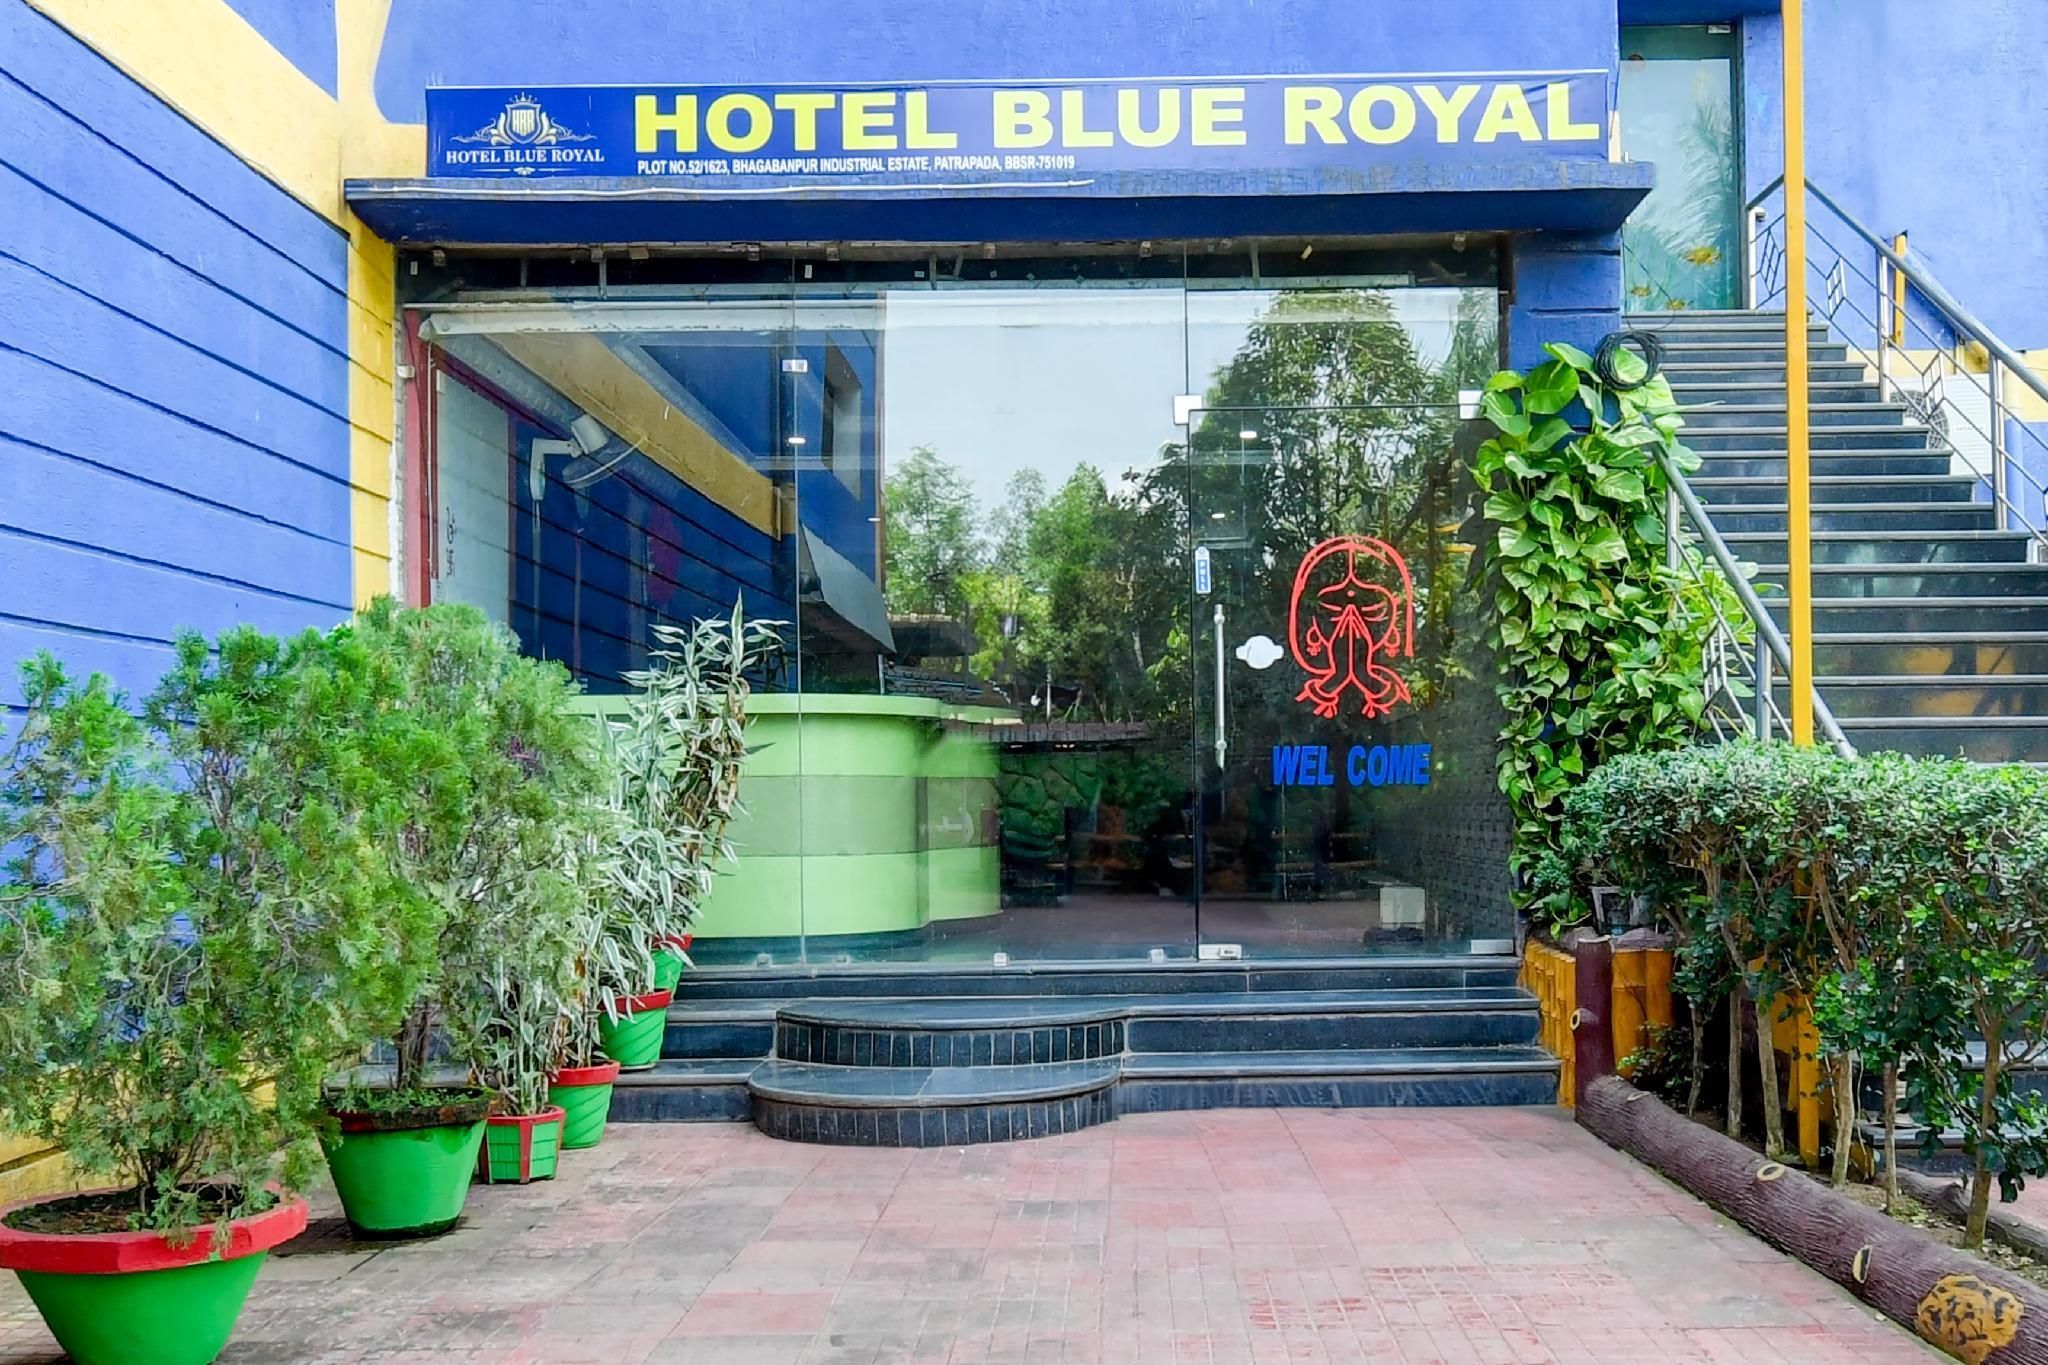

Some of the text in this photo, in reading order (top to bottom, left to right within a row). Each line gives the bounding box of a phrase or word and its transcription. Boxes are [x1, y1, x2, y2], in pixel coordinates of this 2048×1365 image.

[635, 82, 1601, 153] HOTEL BLUE ROYAL
[446, 149, 605, 164] HOTEL BLUE ROYAL
[637, 155, 1076, 176] PLOT NO.52/1623, BHAGABANPUR INDUSTRIAL ESTATE, PATRAPADA, BBSR-751019
[1272, 744, 1432, 787] WEL COME
